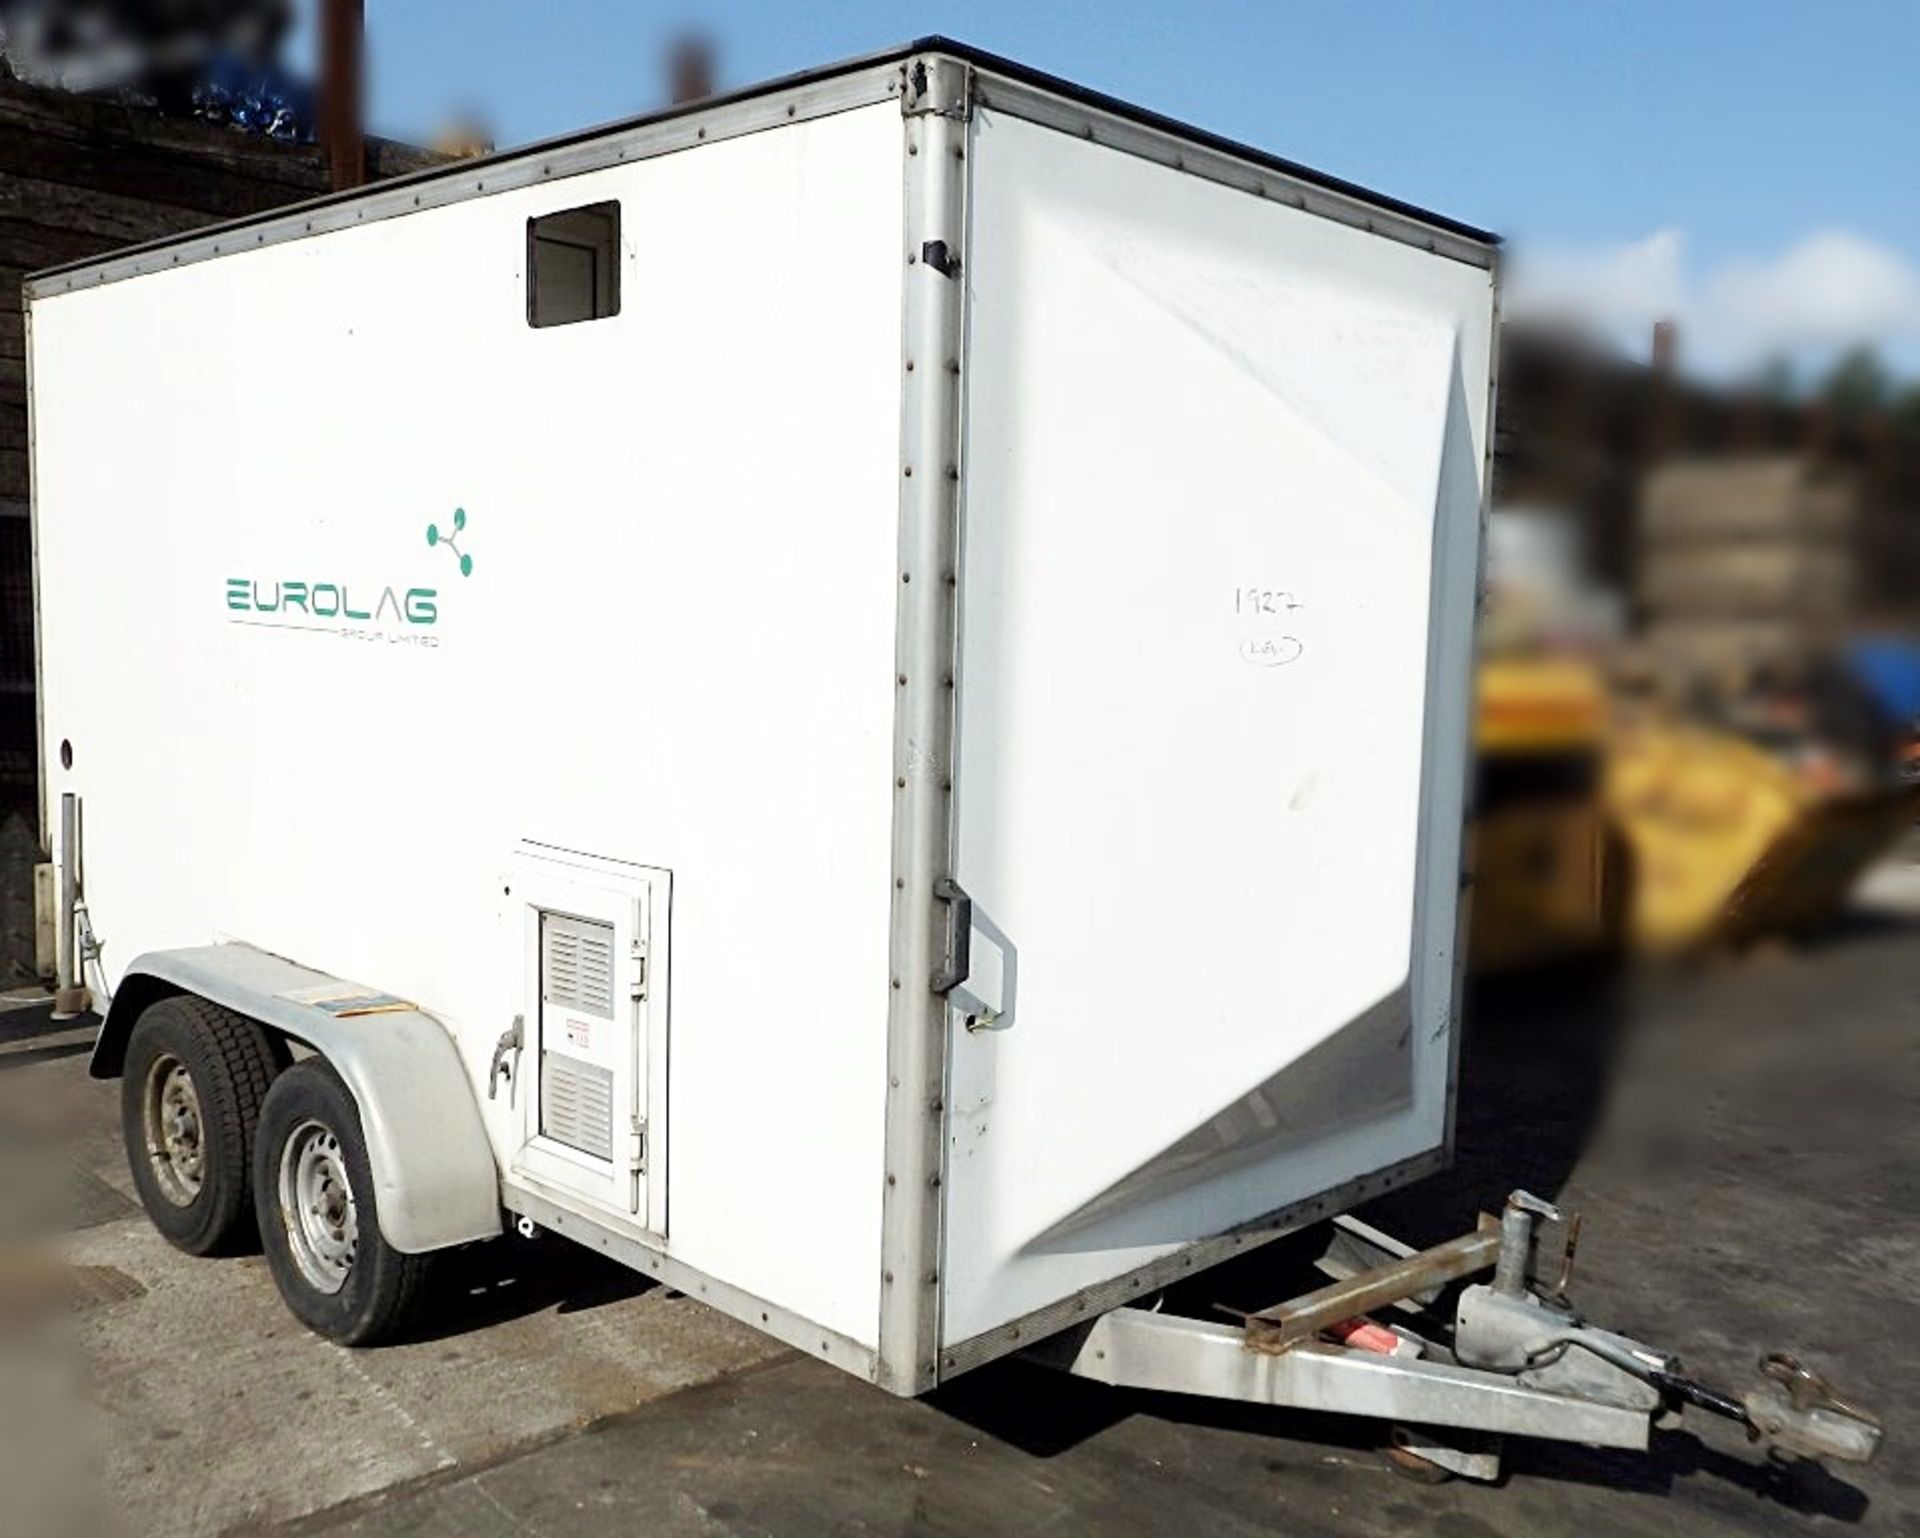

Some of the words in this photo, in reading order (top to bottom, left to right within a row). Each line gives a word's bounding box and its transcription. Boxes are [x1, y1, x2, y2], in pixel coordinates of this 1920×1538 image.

[226, 578, 438, 624] EUROLAG
[1236, 587, 1304, 615] 1927
[340, 627, 384, 642] GROUP
[388, 631, 440, 648] LIMITED
